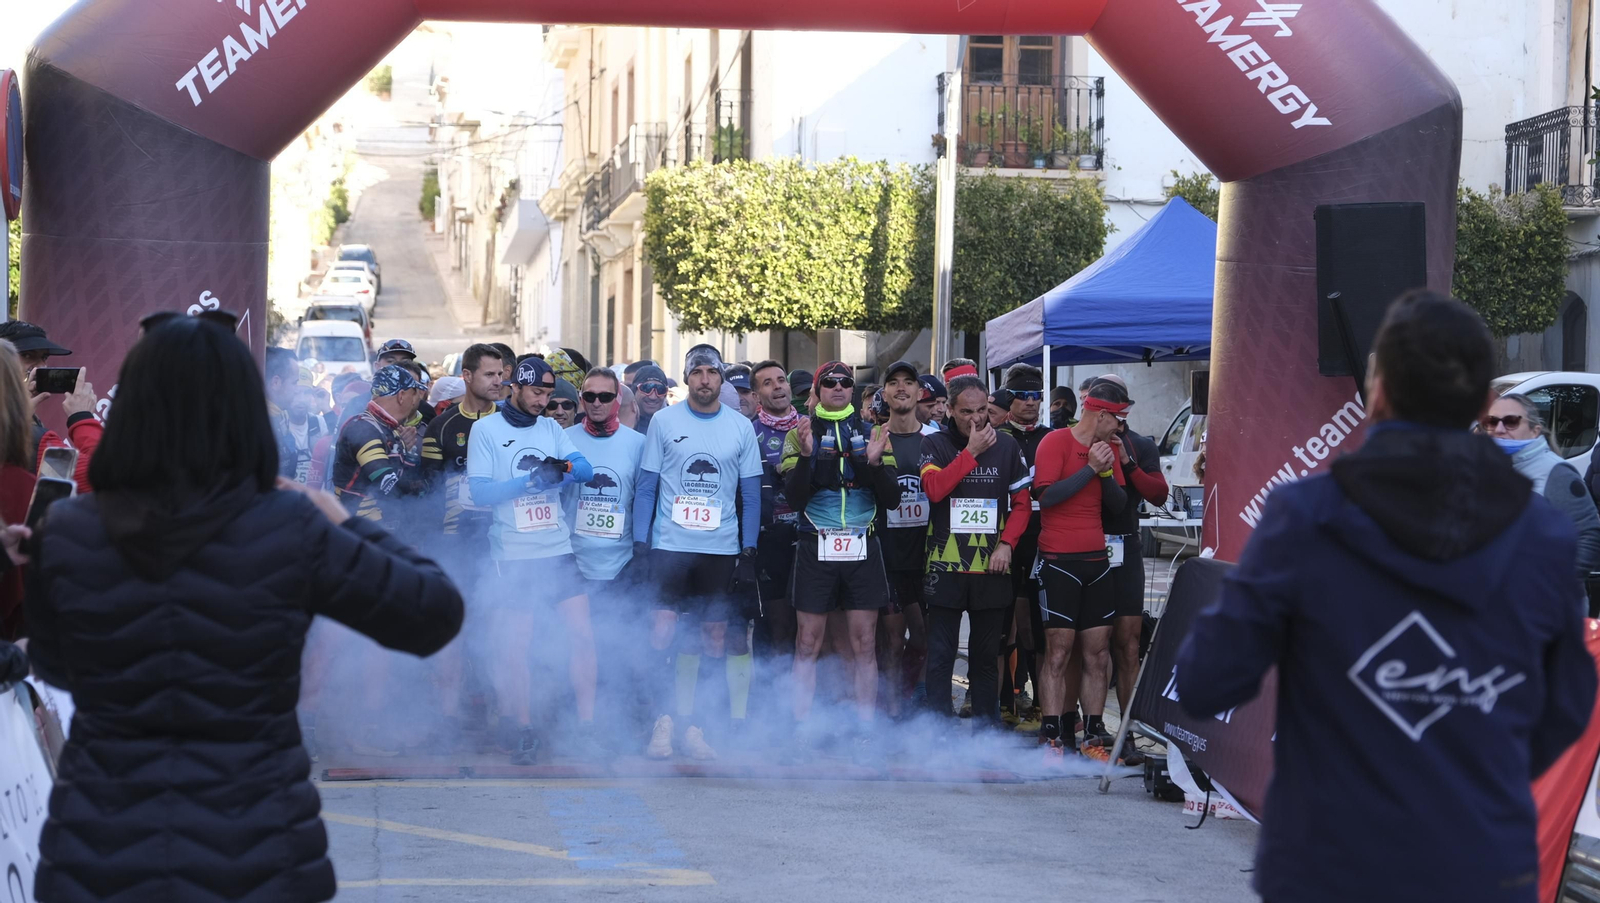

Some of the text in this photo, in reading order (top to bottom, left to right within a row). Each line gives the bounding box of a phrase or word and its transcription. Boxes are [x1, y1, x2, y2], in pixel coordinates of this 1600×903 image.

[176, 0, 307, 107] TEAME
[1176, 0, 1332, 129] AMERGY
[970, 466, 999, 476] ELLAR
[526, 506, 552, 521] 108
[683, 507, 711, 522] 113
[897, 504, 922, 519] 110
[960, 510, 989, 524] 245
[586, 513, 615, 529] 358
[833, 537, 852, 552] 87
[1106, 545, 1114, 559] 8
